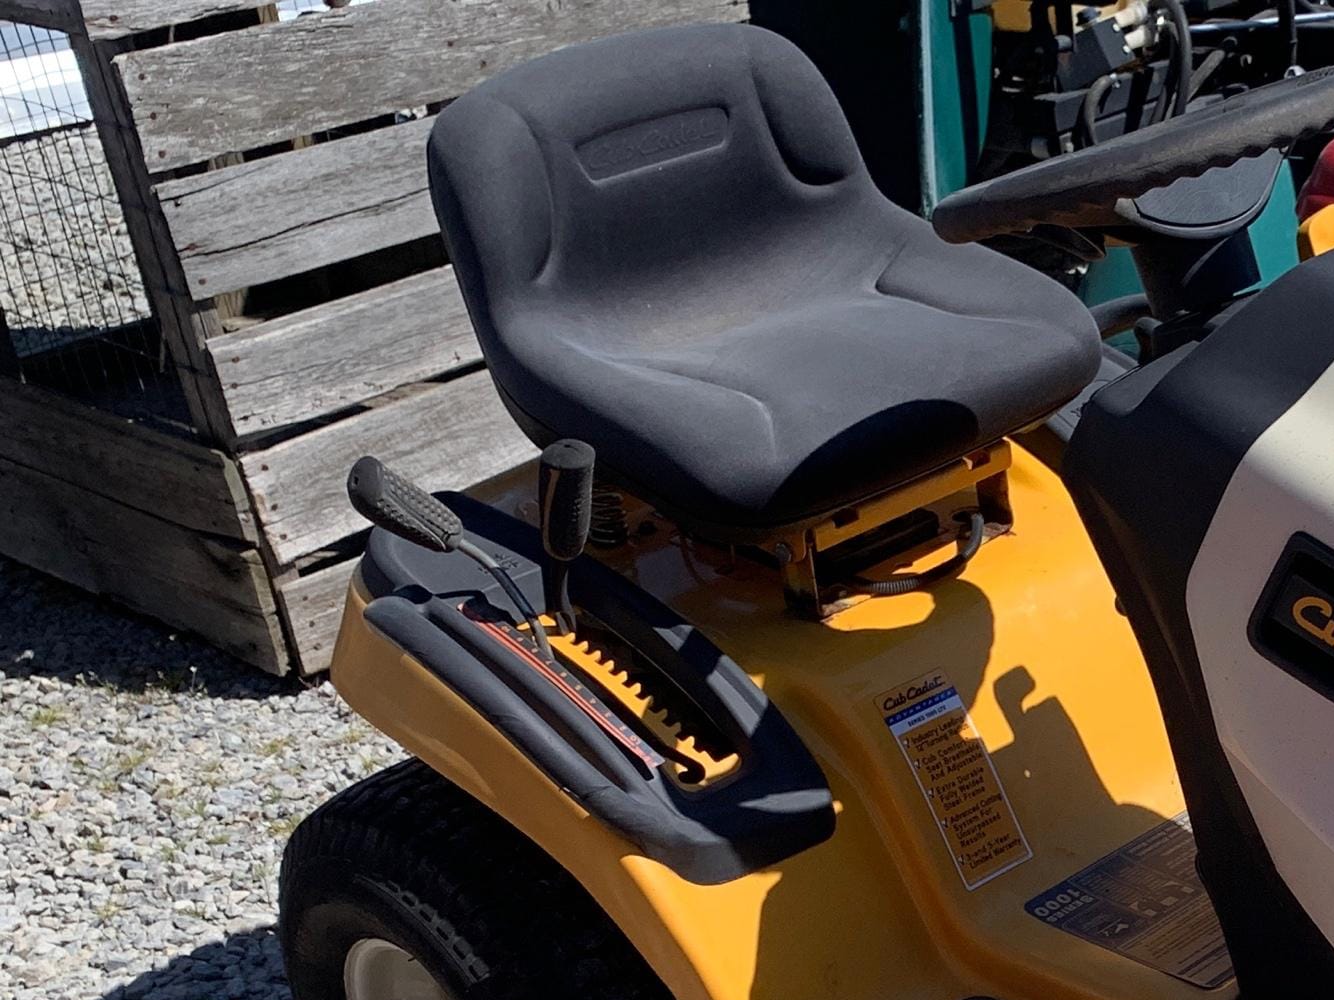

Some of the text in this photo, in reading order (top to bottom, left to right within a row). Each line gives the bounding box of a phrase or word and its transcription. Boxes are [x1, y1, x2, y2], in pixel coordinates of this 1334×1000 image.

[884, 676, 944, 710] Cub Cadet
[911, 728, 938, 744] Industry
[922, 754, 936, 765] Cub
[926, 762, 942, 773] Seat
[931, 753, 982, 781] And Adjustable
[936, 767, 984, 794] Extra Durable
[939, 776, 983, 802] Fully Welded
[944, 786, 985, 811] Steel Frame
[950, 804, 979, 823] Advanced
[953, 816, 979, 831] System
[960, 832, 986, 847] Results
[970, 853, 992, 869] Limited
[1033, 888, 1082, 917] 1000
